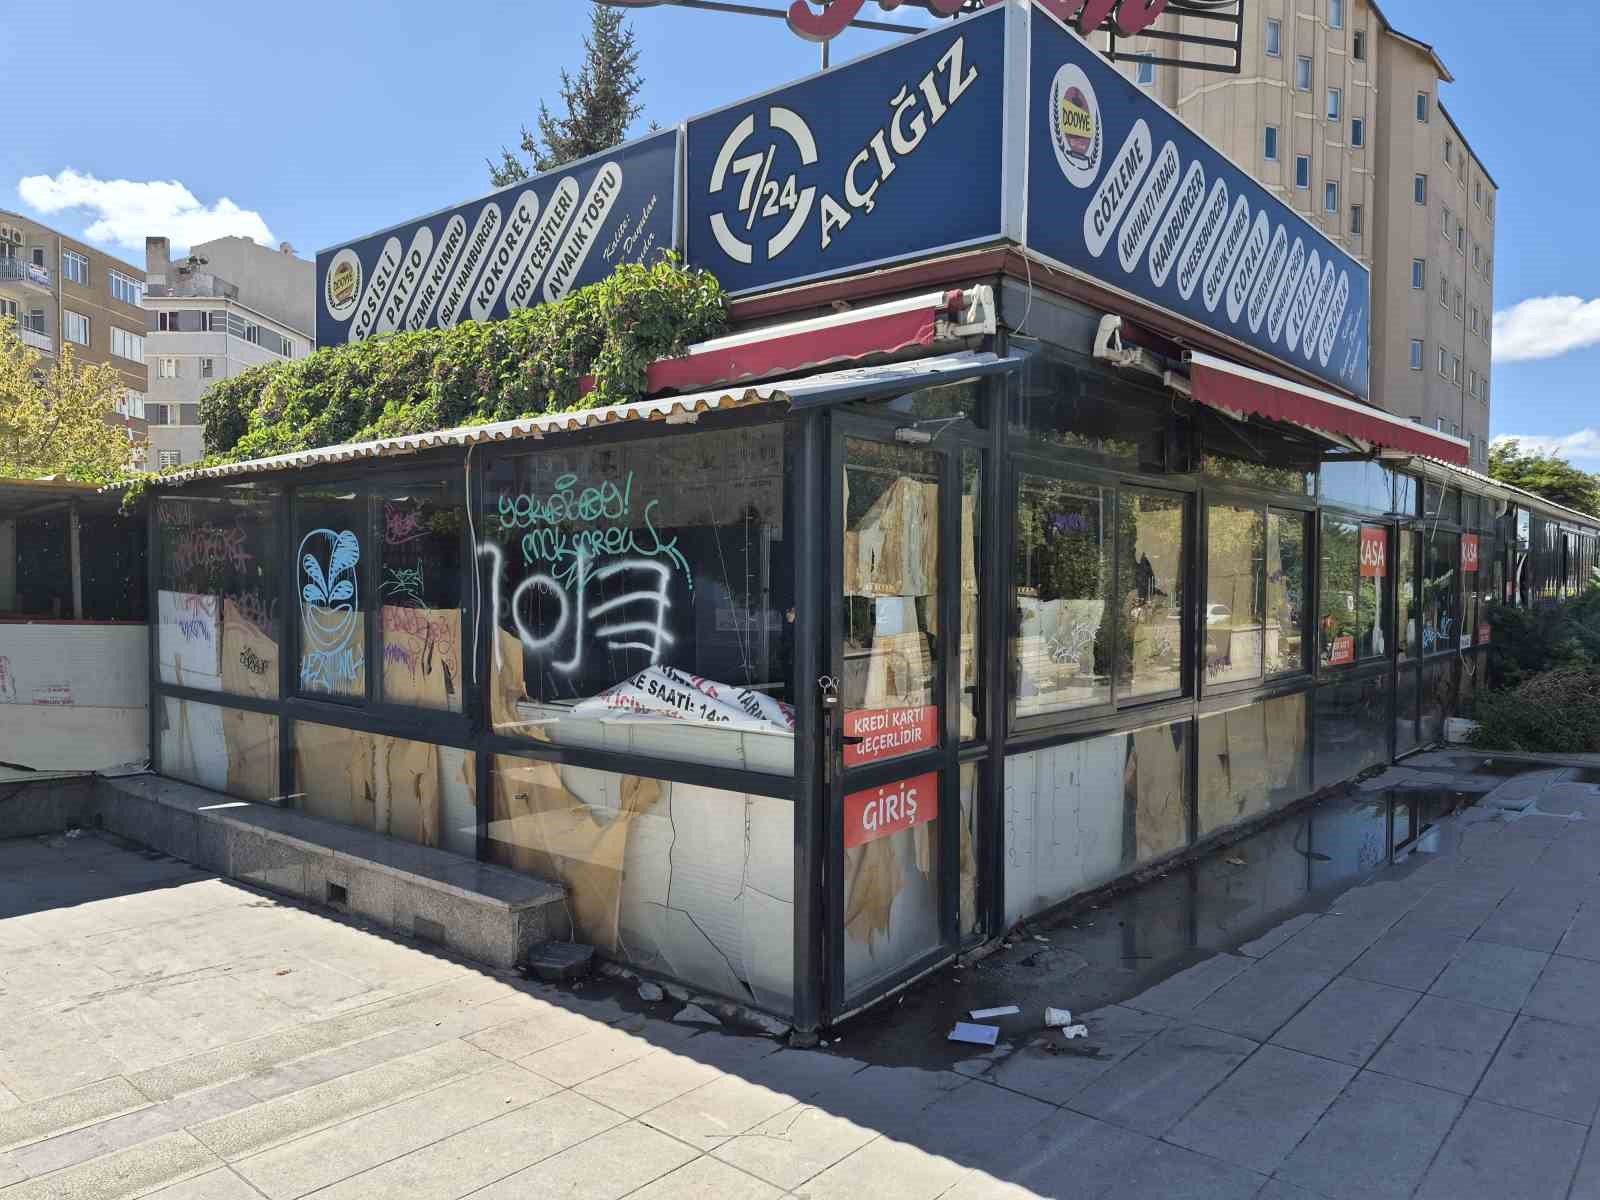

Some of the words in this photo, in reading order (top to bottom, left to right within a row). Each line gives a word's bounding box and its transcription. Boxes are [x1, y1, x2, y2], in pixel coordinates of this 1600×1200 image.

[732, 143, 799, 231] 7/24
[820, 35, 979, 250] AÇIĞIZ
[1093, 137, 1144, 237] GÖZLEME
[440, 287, 461, 326] ISLAK
[456, 209, 498, 292] HAMBURGER
[476, 205, 531, 310] KOKOREÇ
[510, 263, 535, 308] TOST
[530, 185, 574, 271] ÇEŞİTLERİ
[549, 226, 588, 299] AYVALIK
[581, 170, 617, 230] TOSTU
[1121, 190, 1156, 263] KAHVALTI
[1152, 168, 1204, 278] HAMBURGER
[1181, 187, 1227, 292] CHEESEBURGER
[1206, 247, 1229, 303] SUCUK
[1226, 204, 1248, 256] EKMEK
[1234, 227, 1265, 305] GORALI
[355, 251, 395, 341] SOSİSLİ
[386, 249, 422, 325] PATSO
[409, 284, 436, 331] İZMİR
[431, 220, 464, 287] KUMRU
[1292, 265, 1317, 336] KÖFTE
[647, 678, 695, 713] SAATİ:
[854, 709, 890, 735] KREDİ
[892, 706, 925, 727] KARTI
[856, 724, 923, 757] GEÇERLİDİR
[862, 782, 918, 832] GİRİŞ
